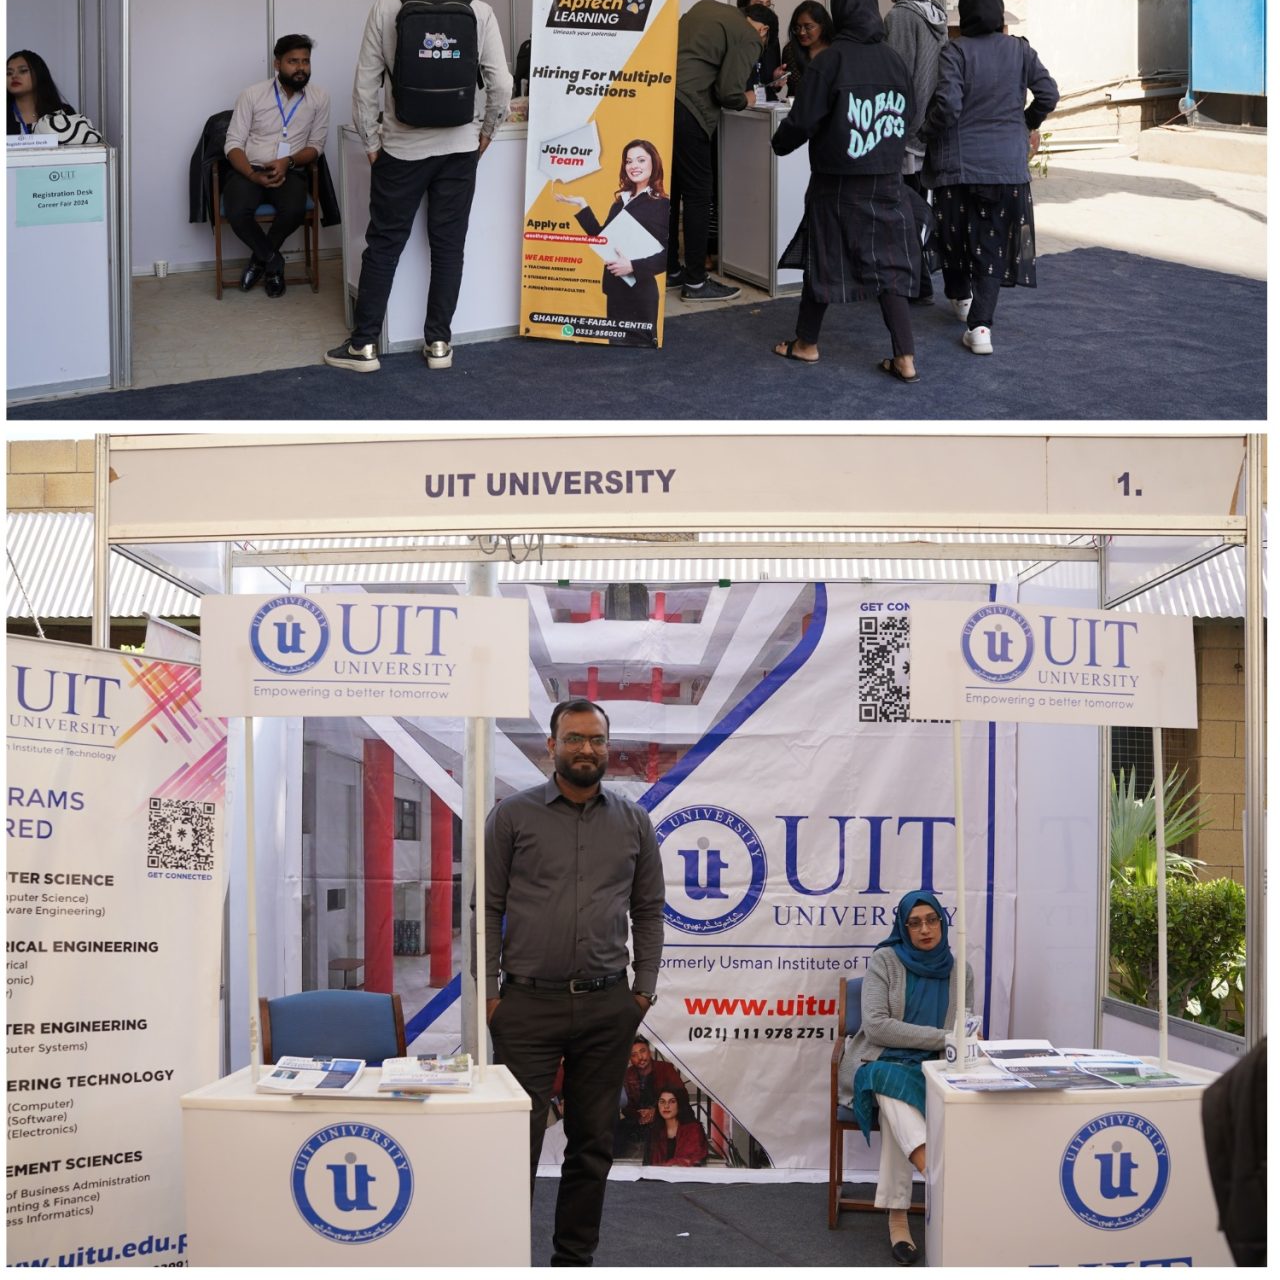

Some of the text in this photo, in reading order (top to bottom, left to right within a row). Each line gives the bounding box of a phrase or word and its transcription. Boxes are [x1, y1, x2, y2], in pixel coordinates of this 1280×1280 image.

[554, 11, 619, 24] LEARNING
[532, 66, 672, 87] Hiring For Multiple
[566, 84, 636, 98] Positions
[847, 90, 905, 132] NO BAD
[847, 115, 895, 159] DAYS
[542, 144, 592, 156] Join Our
[550, 156, 584, 166] Team
[33, 190, 75, 199] Registration
[527, 219, 570, 231] Apply at
[538, 255, 554, 263] ARE
[555, 256, 583, 264] HIRING
[533, 314, 653, 330] SHAHRAH-E-FAISAL CENTER
[575, 328, 626, 338] 0333-9560201
[425, 469, 676, 498] UIT UNIVERSITY
[1118, 472, 1142, 496] 1.
[336, 603, 458, 656] UIT
[1039, 615, 1139, 668] UIT
[334, 661, 456, 677] UNIVERSITY
[1038, 670, 1139, 688] UNIVERSITY
[12, 665, 121, 719] UIT
[254, 686, 449, 699] Empowering a better tomorrow
[10, 714, 120, 737] UNIVERSITY
[12, 743, 52, 754] Institute
[66, 748, 116, 761] Technology
[165, 872, 212, 881] CONNECTED
[688, 1026, 825, 1042] (021) 111 978 275
[38, 1041, 88, 1055] Systems)
[67, 1070, 174, 1088] TECHNOLOGY
[7, 1099, 74, 1113] (Computer)
[7, 1112, 67, 1126] (Software)
[7, 1124, 78, 1140] (Electronics)
[21, 1183, 70, 1199] Business
[73, 1173, 151, 1192] Administration
